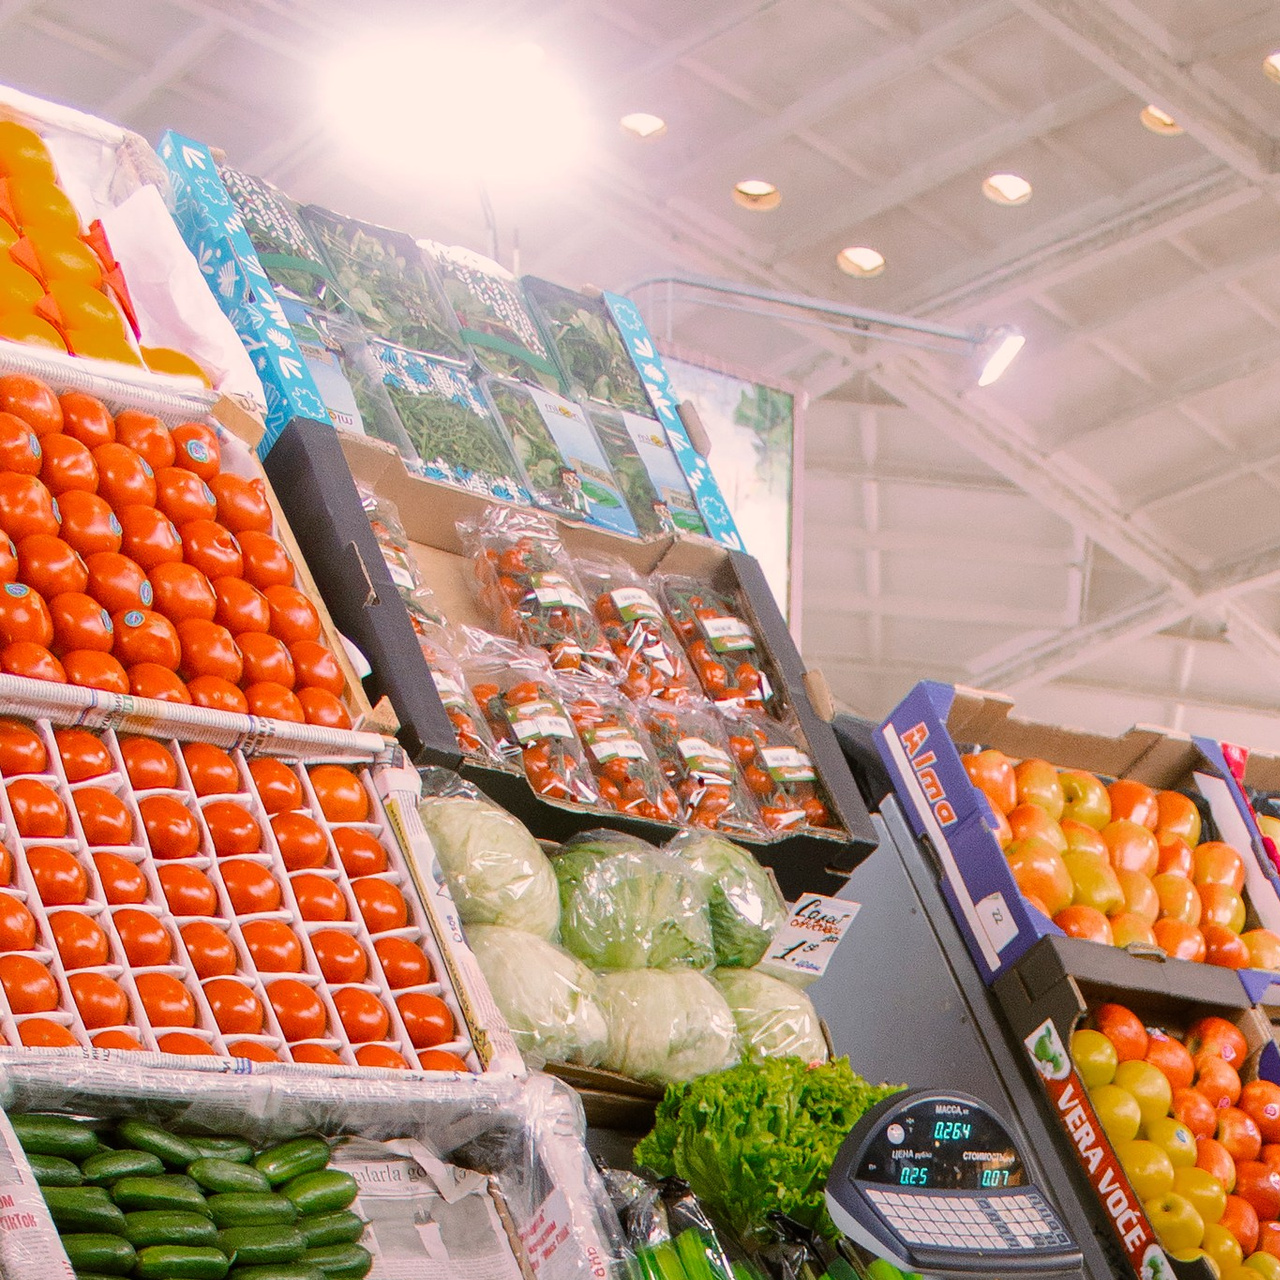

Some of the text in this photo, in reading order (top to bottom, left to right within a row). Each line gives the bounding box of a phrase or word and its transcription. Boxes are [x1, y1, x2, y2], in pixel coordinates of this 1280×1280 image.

[900, 721, 958, 827] Alma
[892, 1150, 914, 1160] ЦЕНА
[1057, 1083, 1147, 1253] VERA VOĆE
